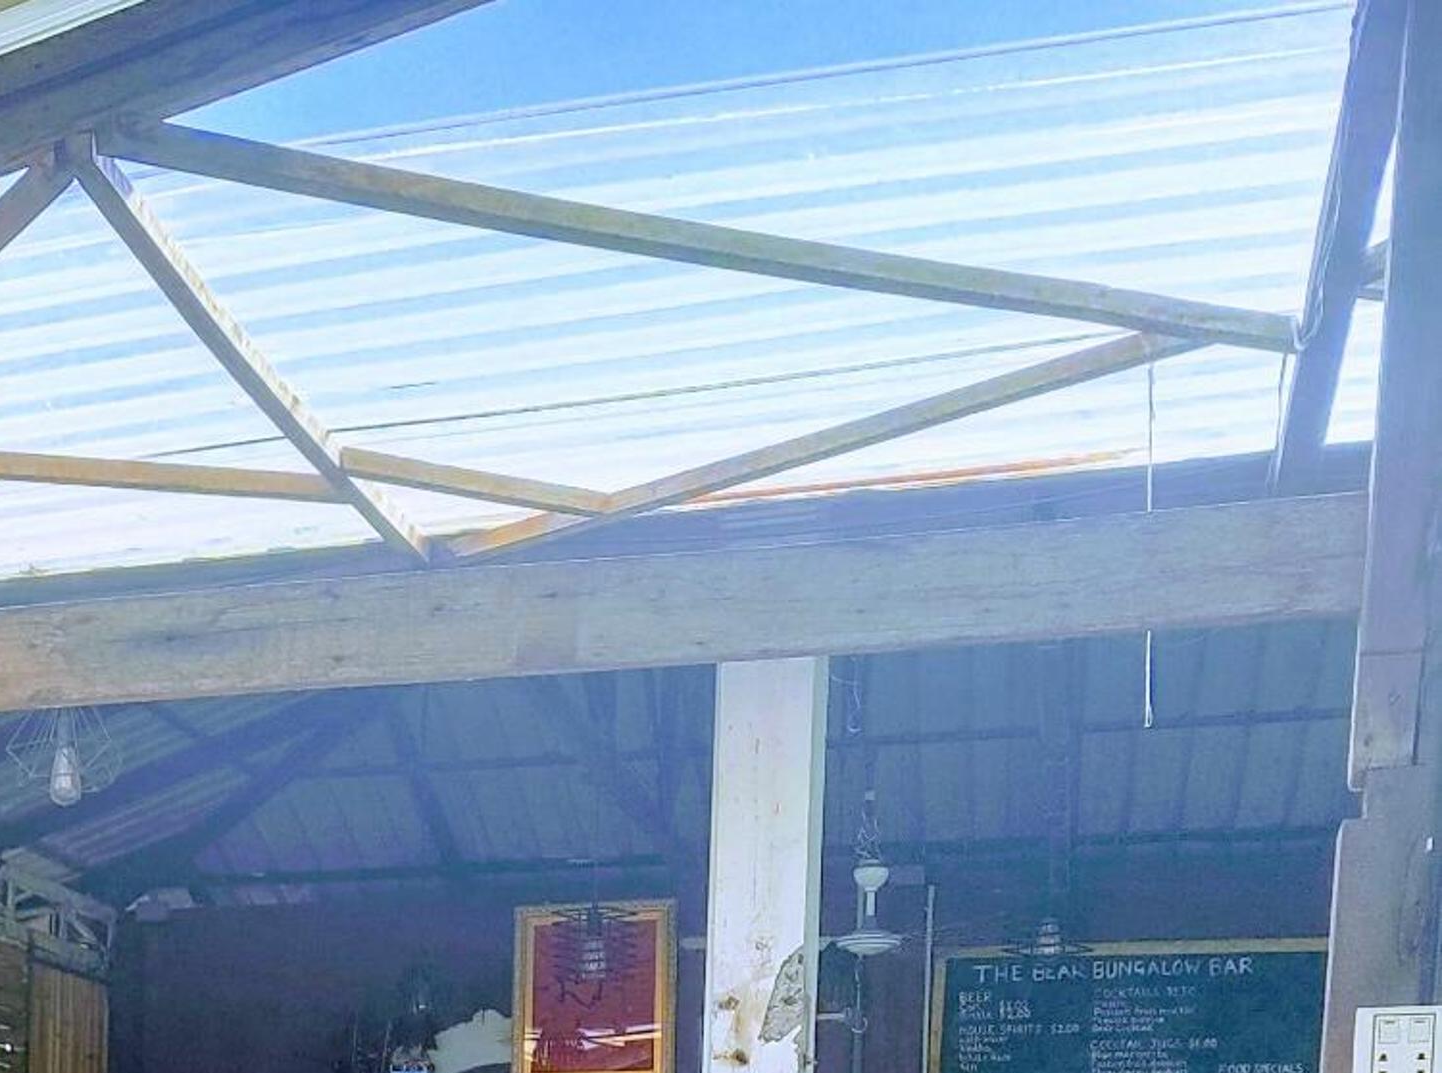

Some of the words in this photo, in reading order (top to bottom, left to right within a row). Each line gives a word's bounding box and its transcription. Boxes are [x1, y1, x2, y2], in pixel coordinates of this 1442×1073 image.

[973, 964, 1023, 983] THE
[1093, 958, 1201, 979] BUNGALOW
[1208, 956, 1254, 977] BAR
